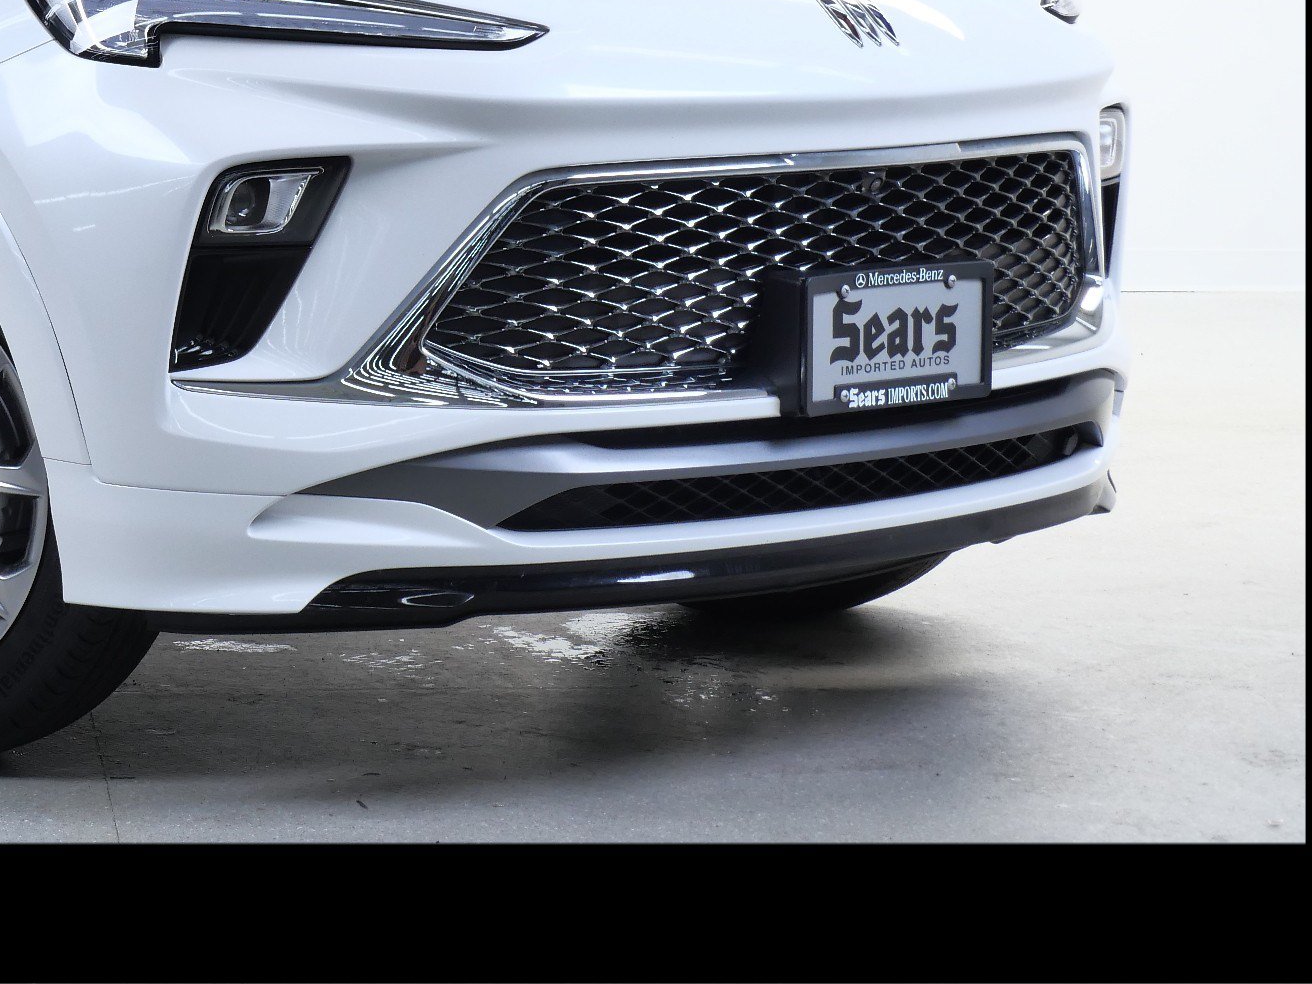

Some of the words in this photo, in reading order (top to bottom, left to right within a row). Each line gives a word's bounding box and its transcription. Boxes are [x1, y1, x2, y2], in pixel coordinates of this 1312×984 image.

[868, 267, 944, 287] Mercedes-Benz
[829, 298, 959, 365] Sears
[841, 360, 906, 376] IMPORTED
[910, 355, 950, 369] AUTOS
[848, 387, 886, 408] Sears
[888, 382, 949, 405] IMPORTS.COM
